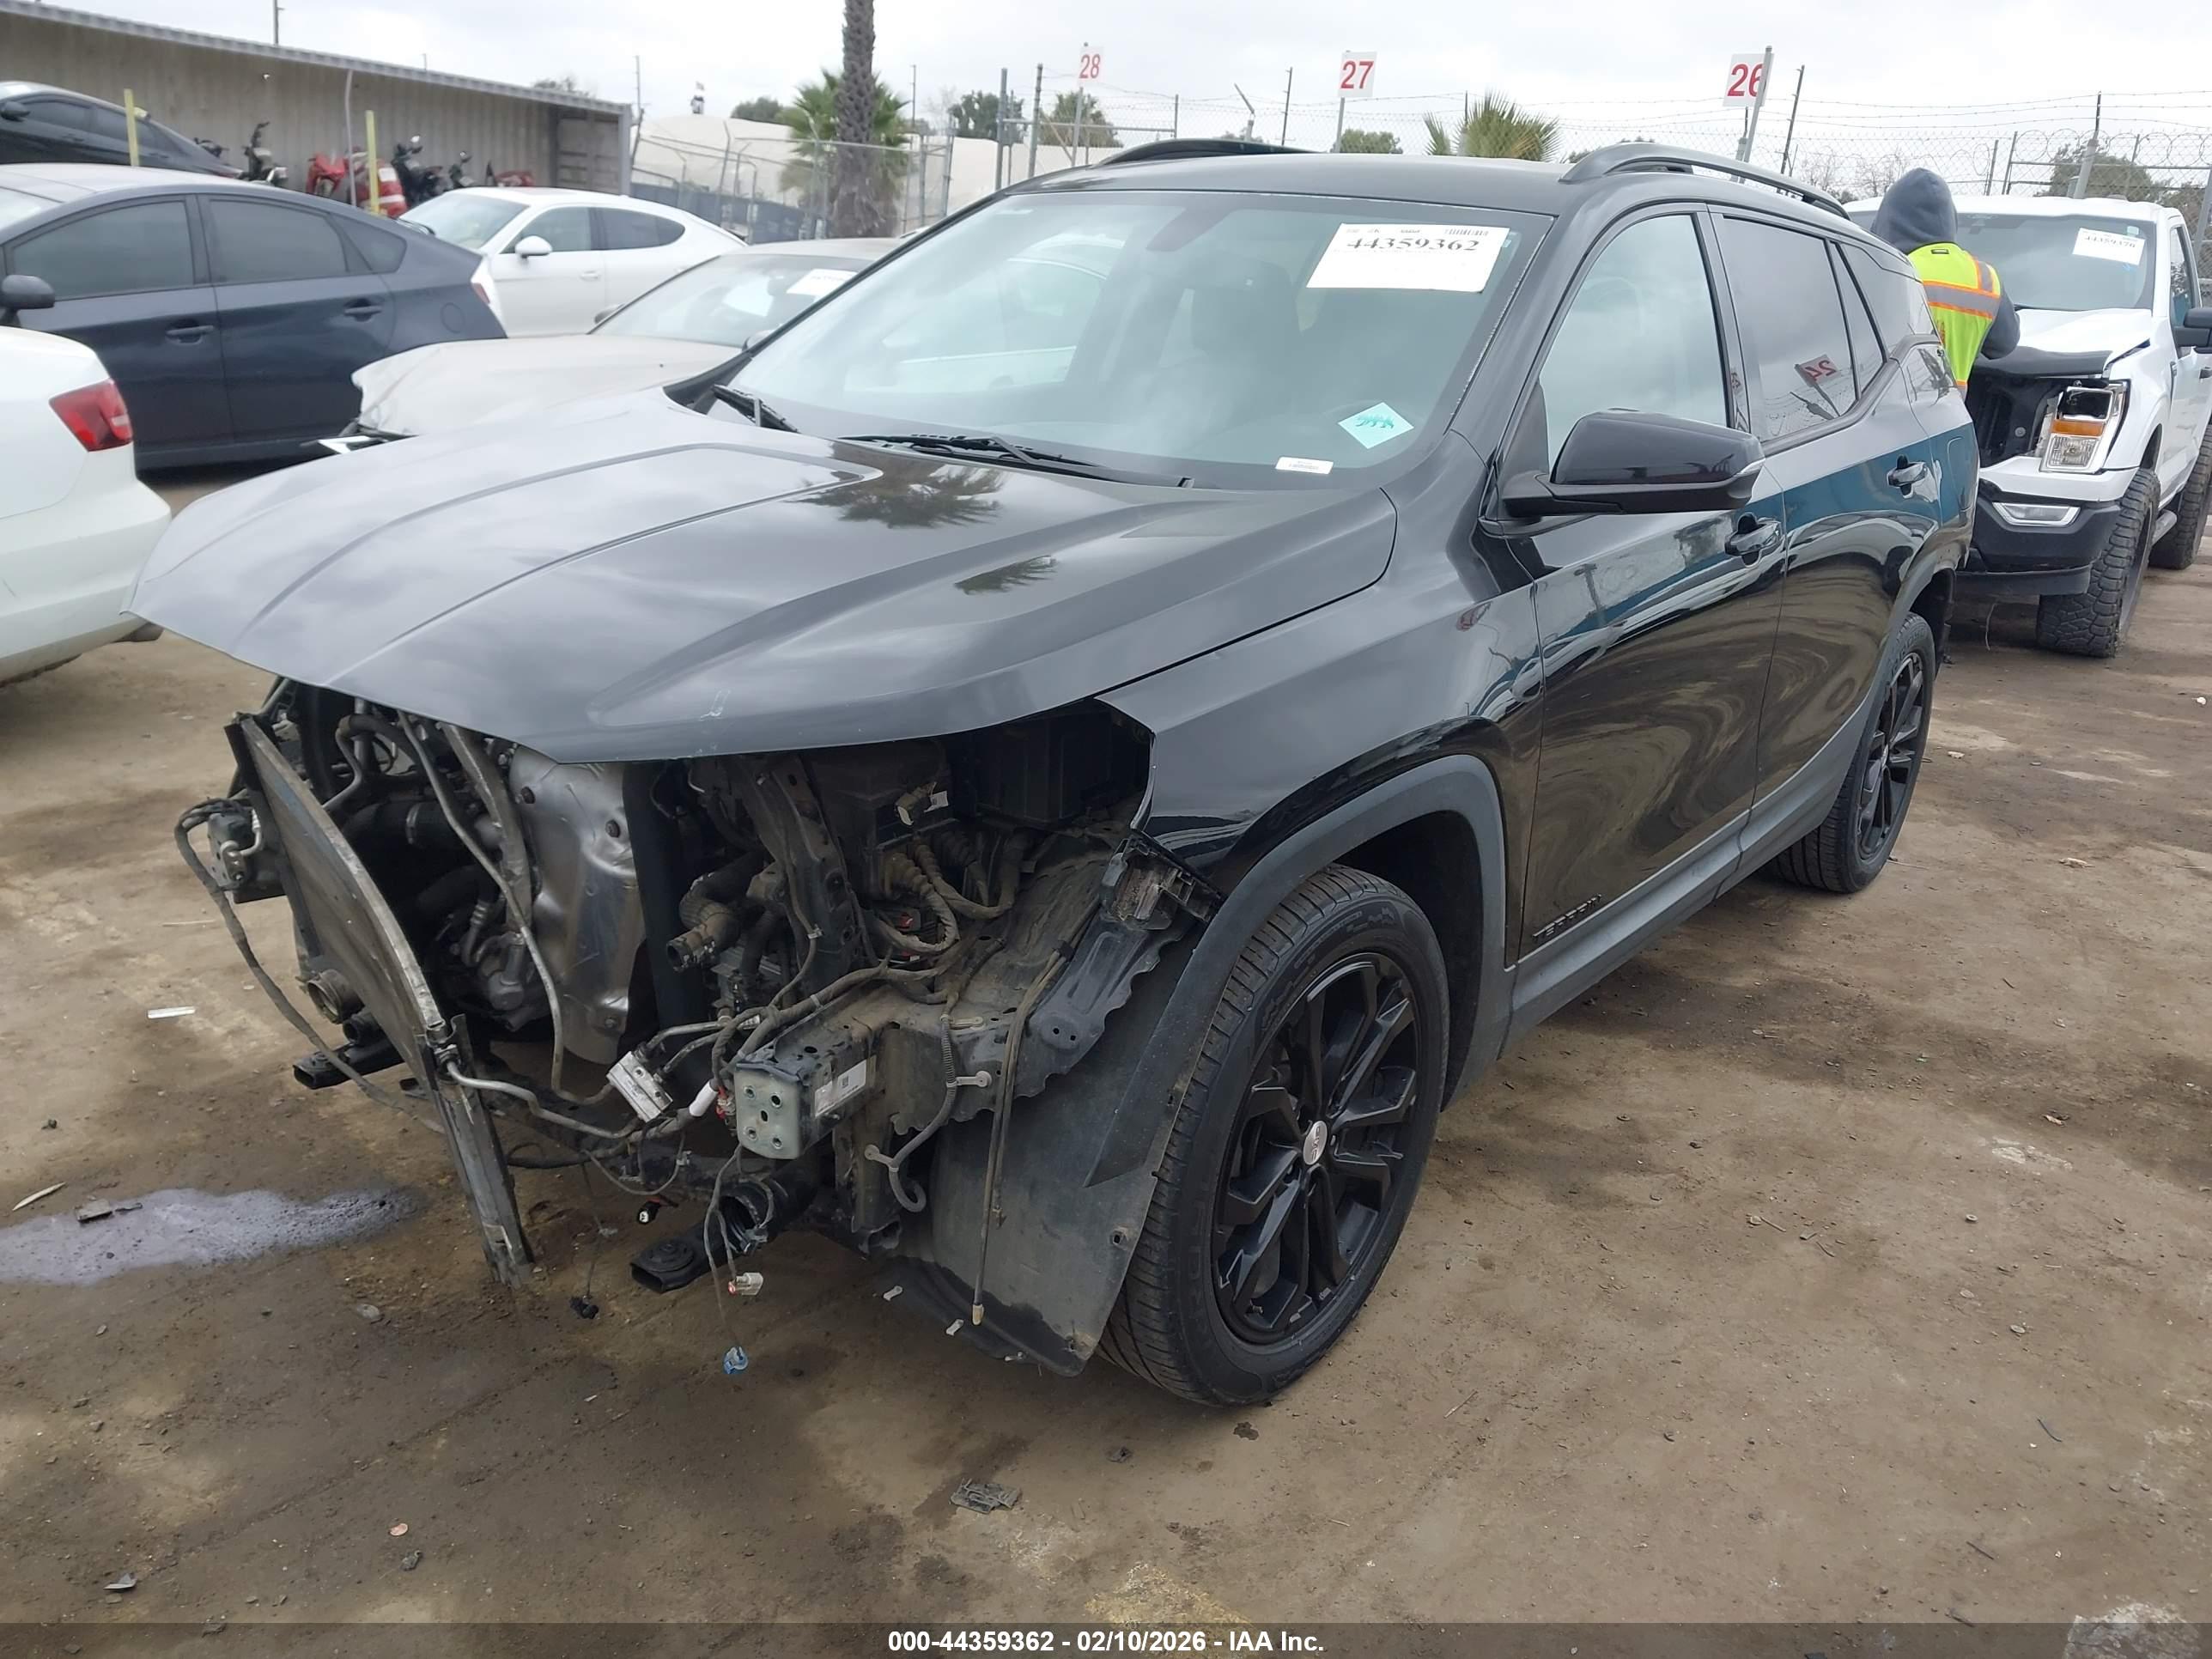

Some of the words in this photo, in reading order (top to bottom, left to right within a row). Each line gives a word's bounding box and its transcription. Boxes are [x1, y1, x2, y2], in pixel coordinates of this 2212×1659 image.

[1079, 53, 1101, 79] 28
[1340, 60, 1375, 89] 27
[1727, 63, 1763, 97] 26
[1346, 237, 1480, 252] 44359362
